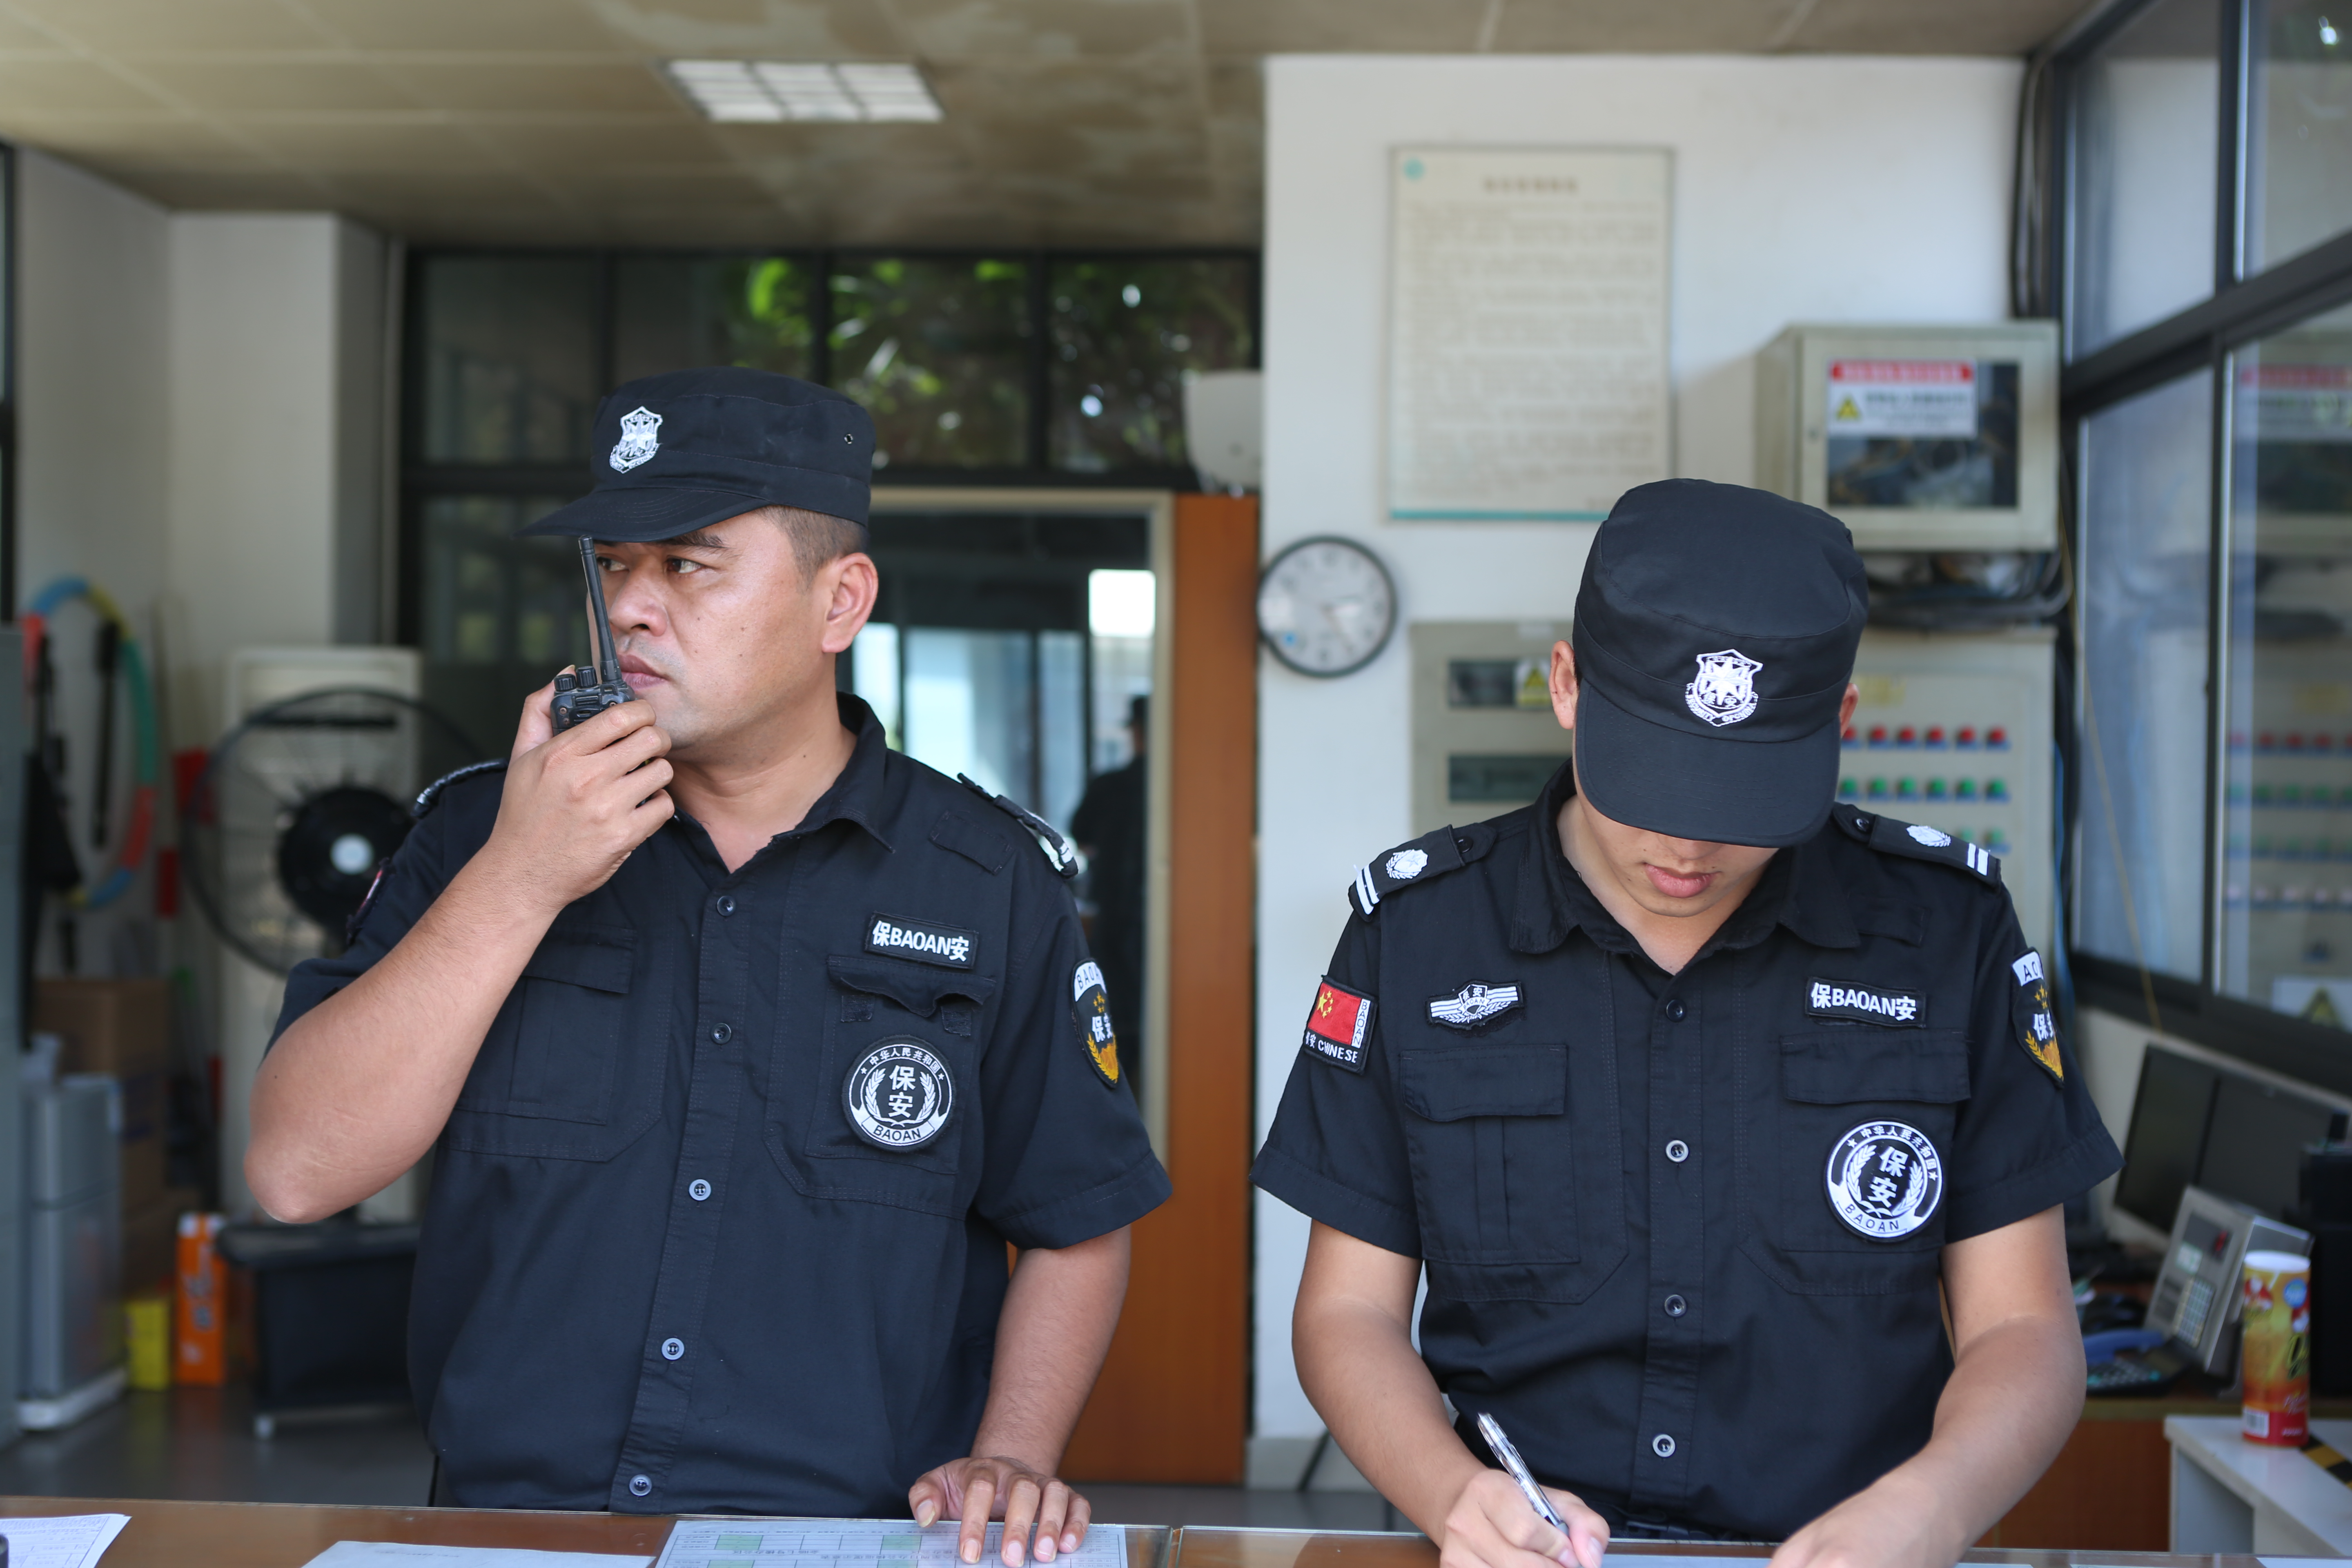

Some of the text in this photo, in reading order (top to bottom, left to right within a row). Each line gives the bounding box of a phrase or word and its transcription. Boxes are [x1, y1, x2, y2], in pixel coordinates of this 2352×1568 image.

[873, 920, 969, 962] 保BAOAN安
[1811, 982, 1916, 1021] 保BAOAN安
[1092, 1013, 1113, 1042] 保安
[1353, 1001, 1368, 1046] BAOAN
[869, 1047, 941, 1074] 中华人民共和国
[1318, 1040, 1358, 1063] CHINESE
[889, 1065, 916, 1118] 保安
[873, 1125, 921, 1141] BAOAN
[1860, 1126, 1937, 1170] 中华人民共和国
[1867, 1146, 1909, 1208] 保安
[1845, 1203, 1900, 1232] BAOAN
